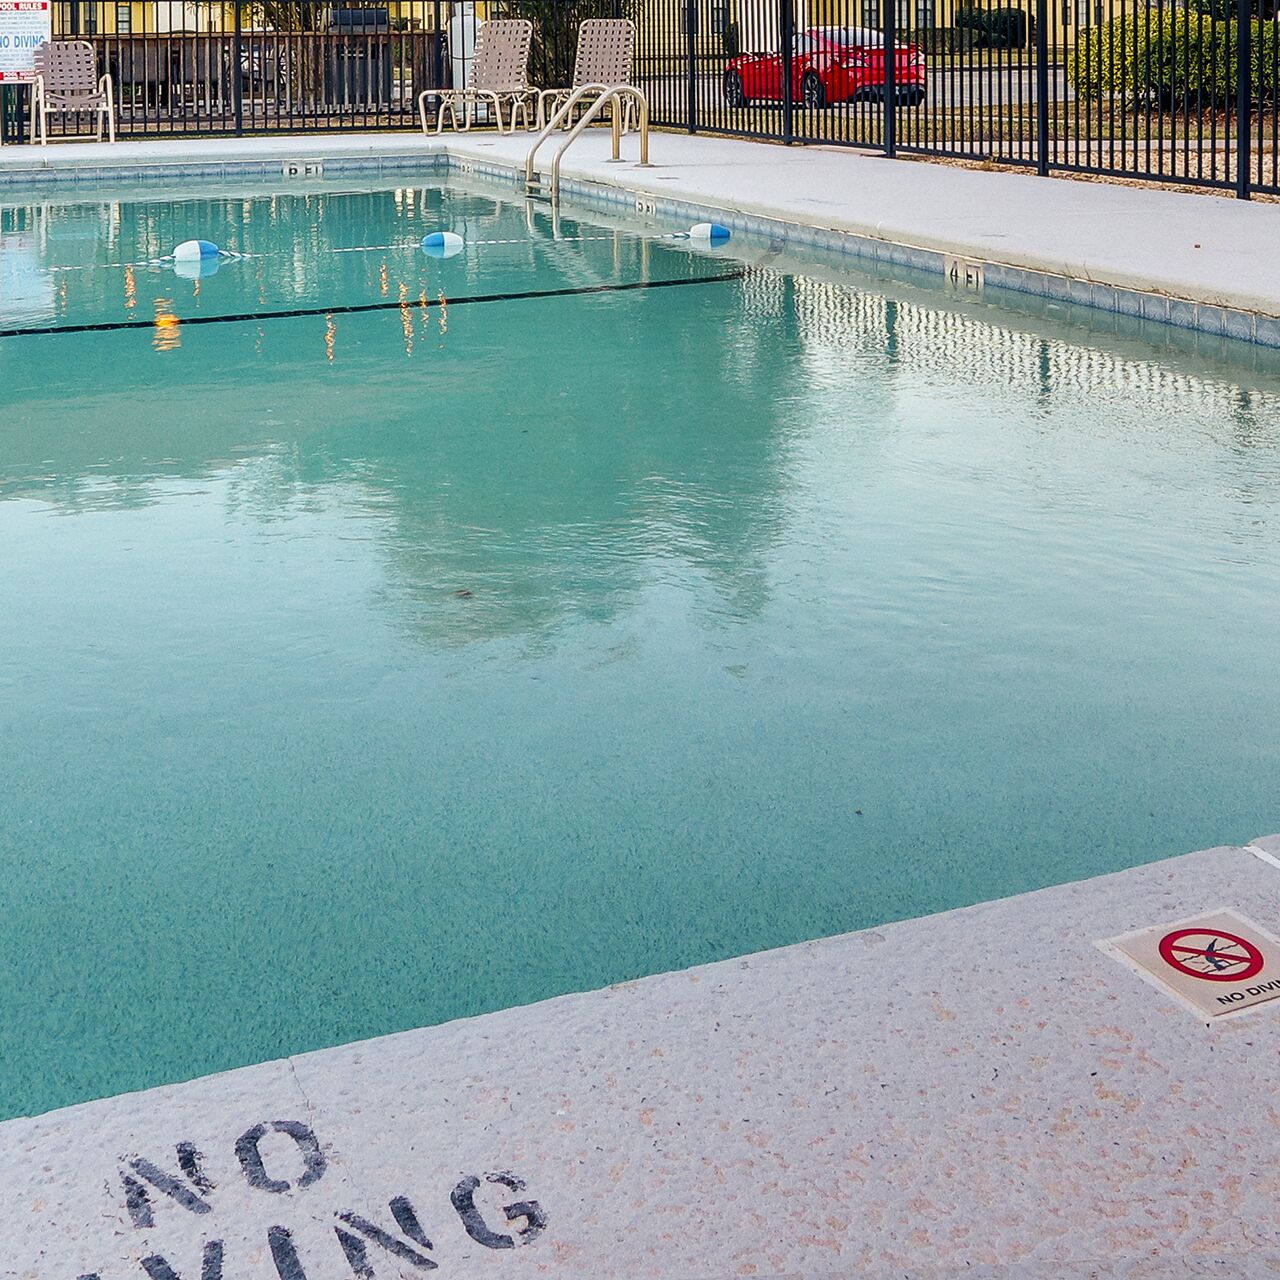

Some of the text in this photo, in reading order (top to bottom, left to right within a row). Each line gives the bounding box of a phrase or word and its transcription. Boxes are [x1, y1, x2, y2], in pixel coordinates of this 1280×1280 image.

[18, 2, 42, 10] RULES
[1216, 989, 1246, 1006] NO
[118, 1119, 328, 1230] NO
